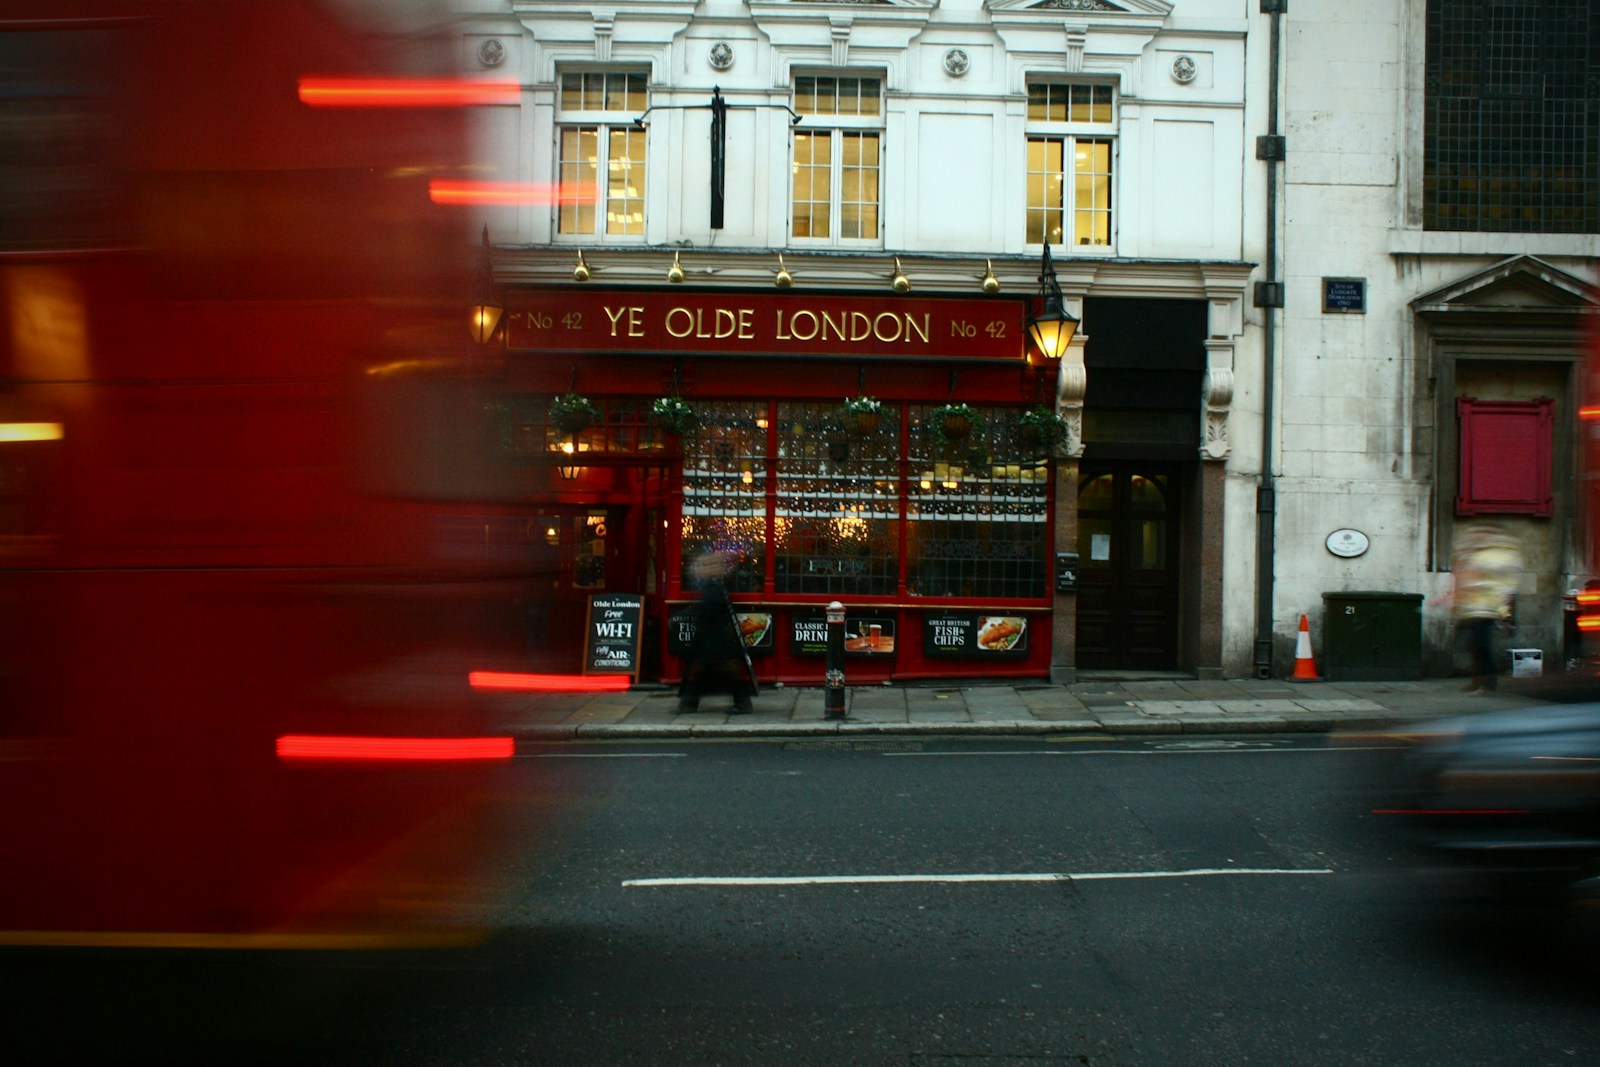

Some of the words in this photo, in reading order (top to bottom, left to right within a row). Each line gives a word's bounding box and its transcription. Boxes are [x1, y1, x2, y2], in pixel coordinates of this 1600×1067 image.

[527, 312, 553, 329] No
[561, 312, 582, 330] 42
[603, 306, 645, 337] YE
[665, 307, 755, 340] OLDE
[776, 309, 930, 343] LONDON
[951, 319, 977, 338] No
[985, 320, 1006, 338] 42
[1345, 605, 1355, 615] 21
[595, 622, 633, 638] WI-FI
[679, 622, 697, 632] FIS
[795, 622, 824, 630] CLASSIC
[934, 635, 965, 646] CHIPS
